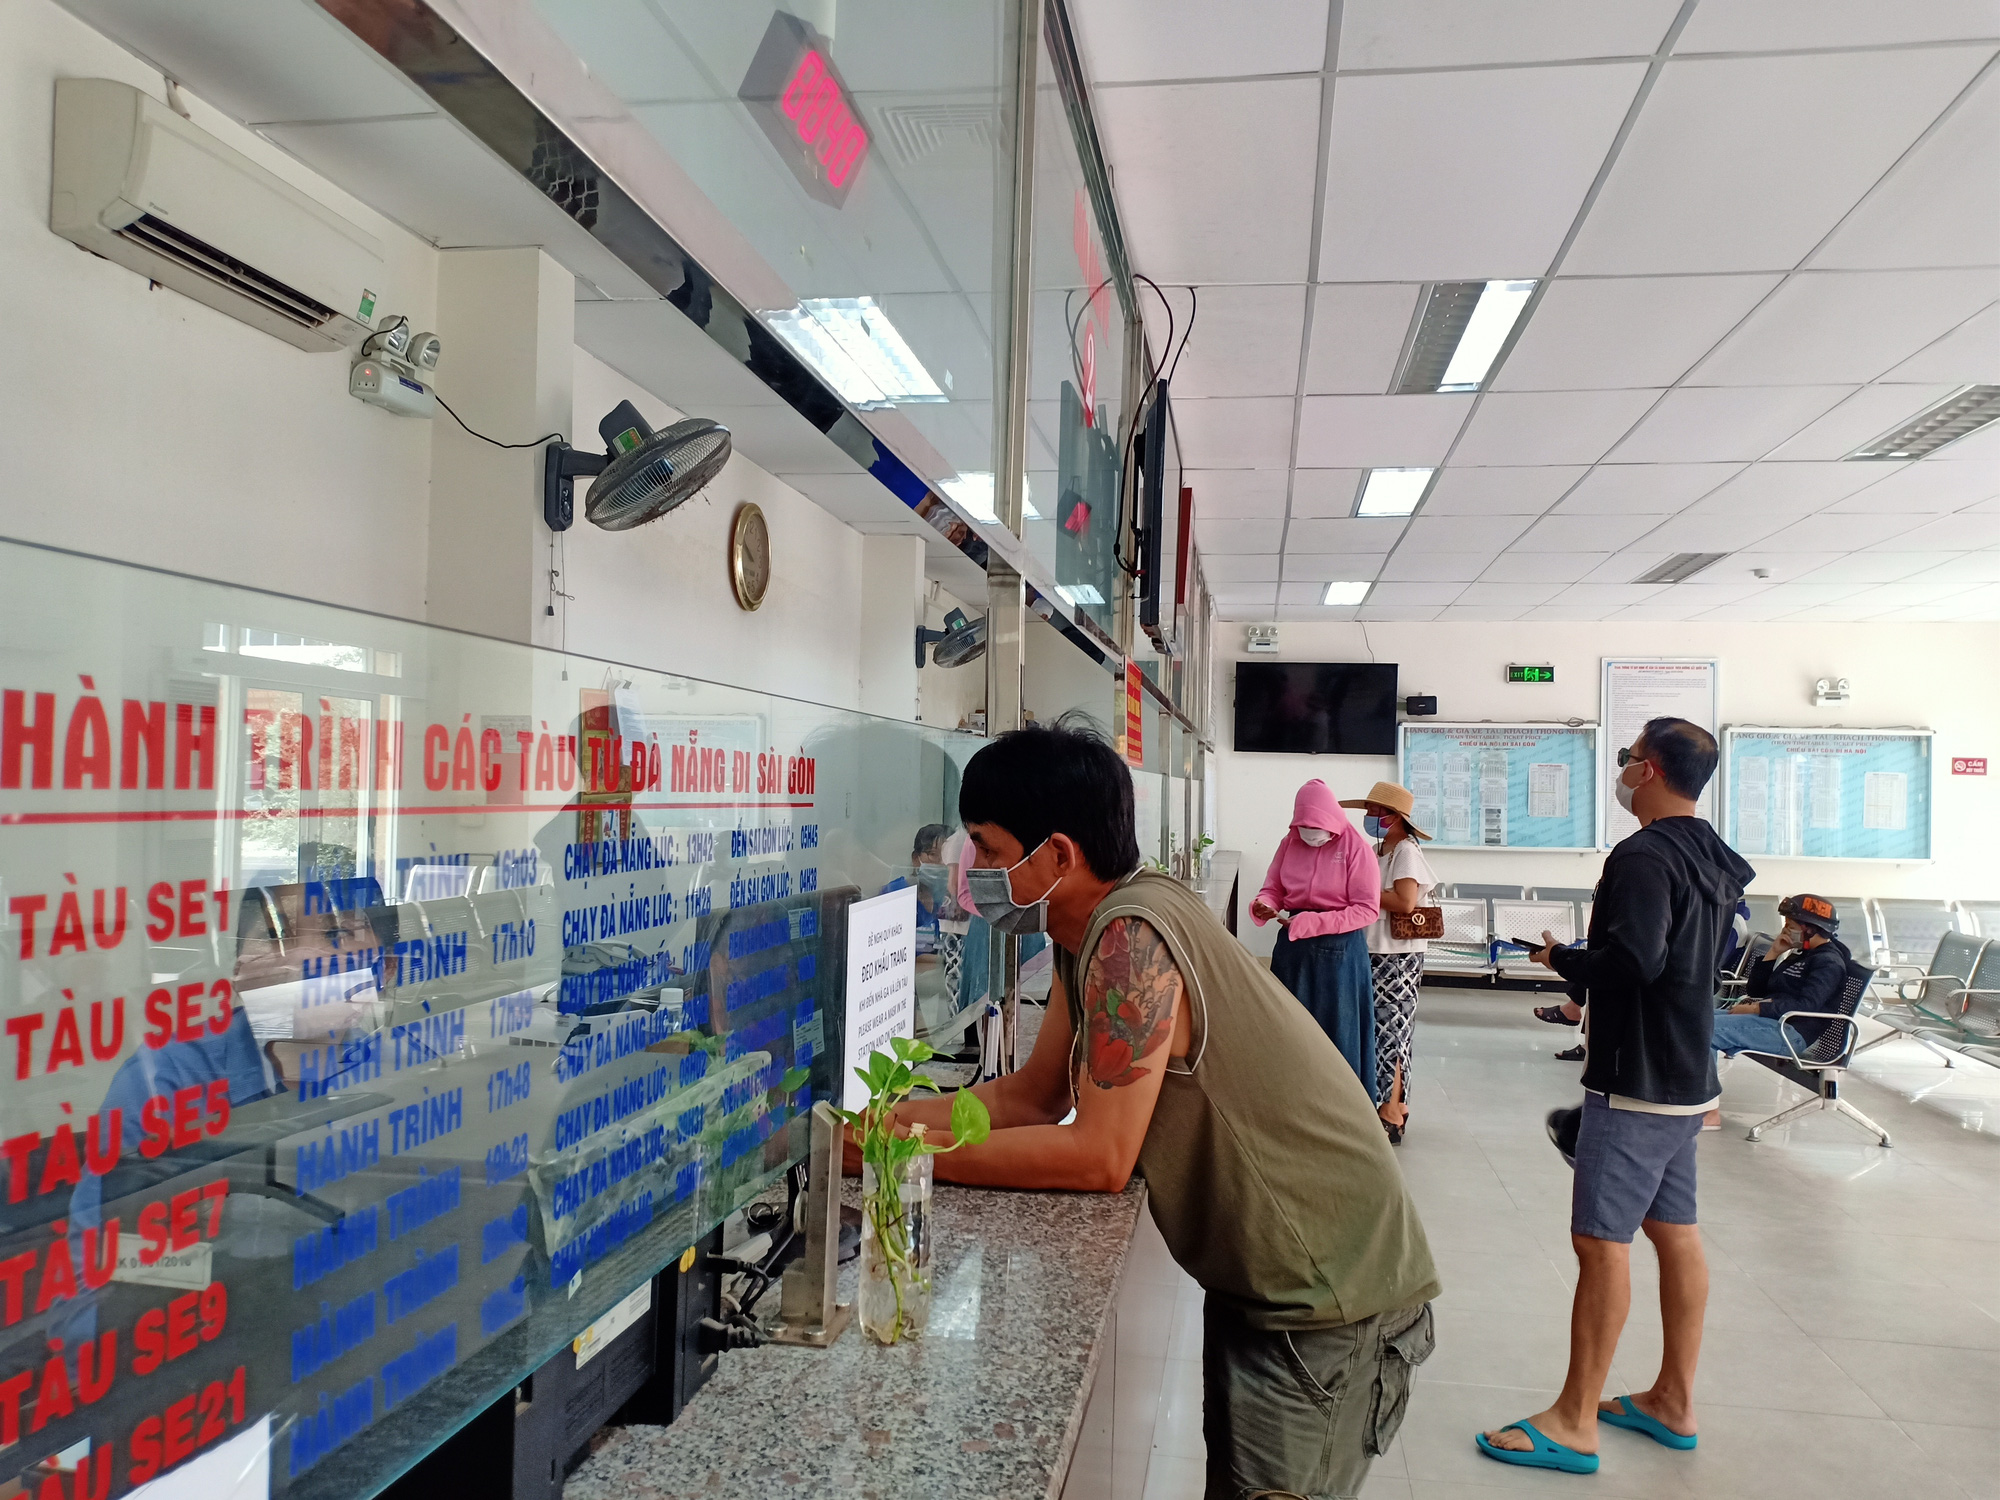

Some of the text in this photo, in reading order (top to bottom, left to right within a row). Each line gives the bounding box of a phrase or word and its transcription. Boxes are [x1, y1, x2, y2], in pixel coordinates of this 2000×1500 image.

[2, 673, 815, 795] HÀNH TRÌNH CÁC TÀU TỪ ĐÀ NẴNG ĐI SÀI GÒN
[564, 842, 599, 889] CHẠY
[602, 830, 617, 876] ĐÀ
[686, 833, 713, 864] 13H42
[731, 817, 747, 858] ĐẾN
[762, 819, 777, 854] GÒN
[800, 824, 818, 849] 05H45
[9, 872, 229, 961] TÀU SE1
[562, 906, 597, 955] CHẠY
[600, 893, 617, 940] ĐÀ
[685, 886, 712, 920] 11H28
[730, 867, 746, 909] ĐẾN
[747, 869, 760, 906] SÀI
[761, 867, 776, 903] GÒN
[394, 923, 467, 987] TRÌNH
[492, 918, 536, 965] 17h10
[861, 962, 874, 983] ĐEO
[890, 946, 908, 969] TRANG
[6, 978, 233, 1081] TÀU SE3
[298, 1029, 382, 1103] HÀNH
[391, 1000, 465, 1071] TRÌNH
[596, 1019, 611, 1067] ĐÀ
[858, 1019, 872, 1039] PLEASE
[872, 1012, 883, 1029] WEAR
[0, 1078, 230, 1205] TÀU SE5
[296, 1061, 531, 1197] HÀNH TRÌNH 17h48
[556, 1102, 591, 1154] CHẠY
[594, 1083, 608, 1133] ĐÀ
[0, 1177, 230, 1328] TÀU SE7
[0, 1281, 228, 1446] TÀU SE9
[129, 1365, 246, 1485] SE21
